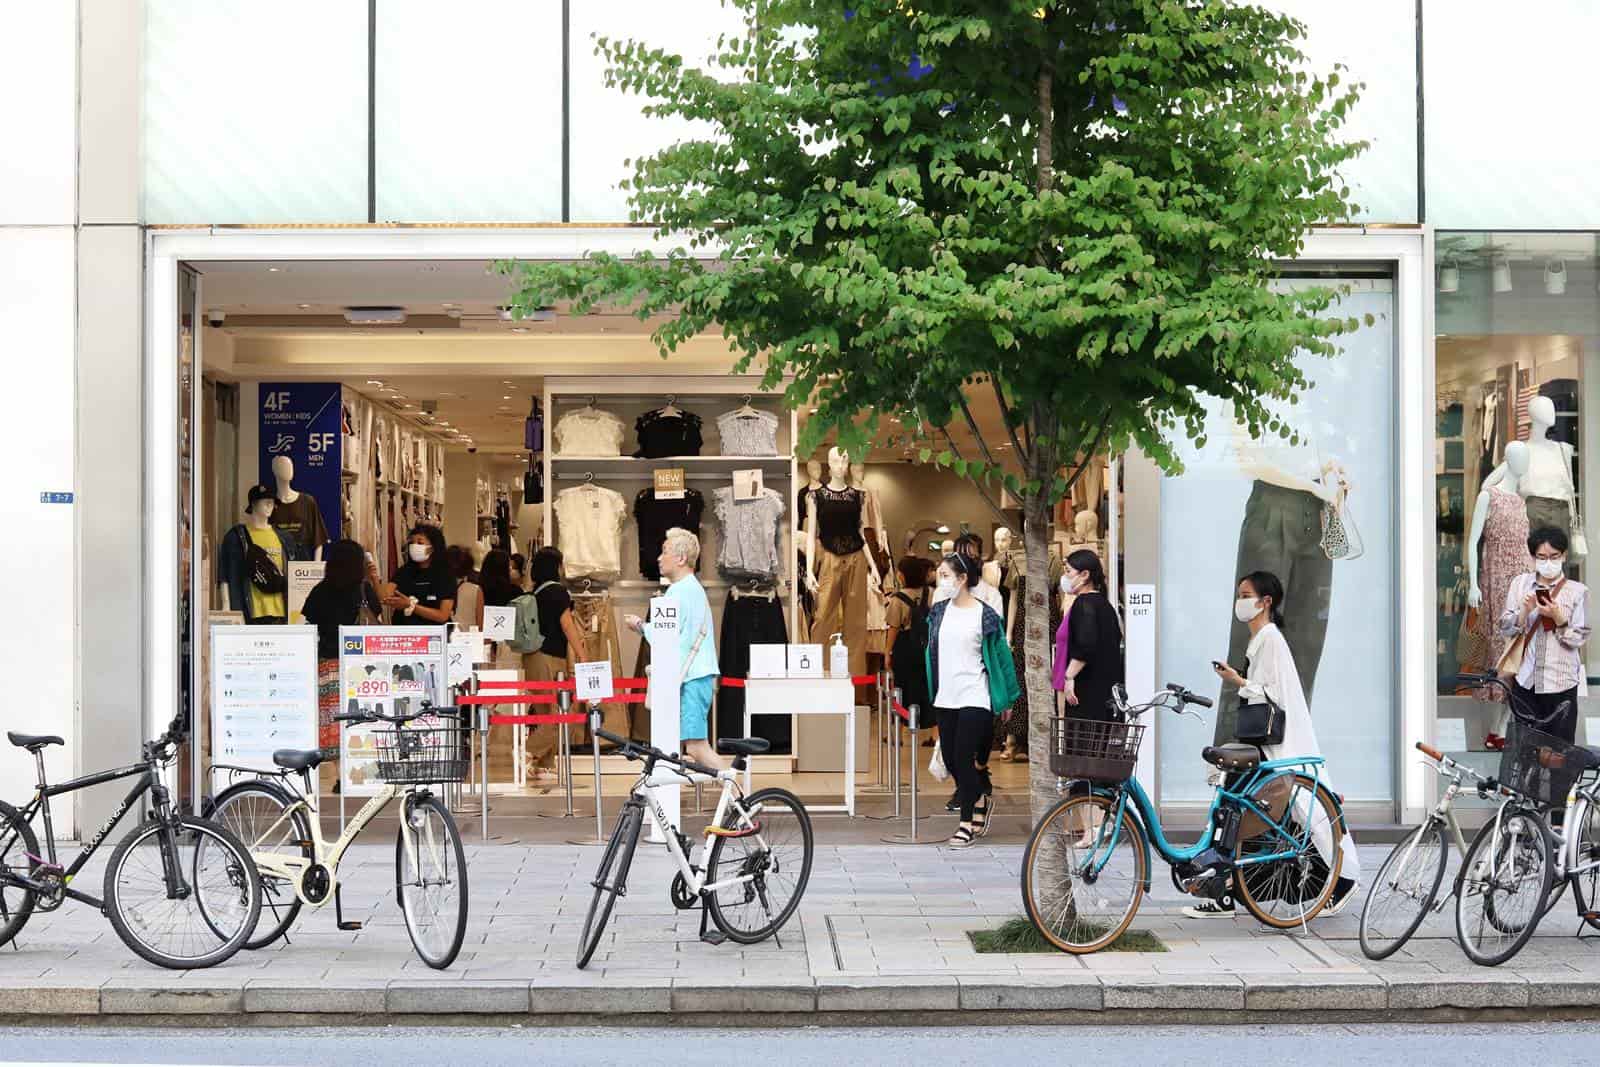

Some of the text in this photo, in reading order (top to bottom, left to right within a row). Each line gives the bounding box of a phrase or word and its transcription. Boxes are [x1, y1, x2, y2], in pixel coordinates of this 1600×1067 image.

[264, 392, 290, 411] 4F
[308, 433, 335, 452] 5F
[308, 454, 324, 462] MEN
[658, 472, 680, 482] NEW
[295, 569, 309, 577] GU
[1129, 593, 1152, 604] 出口
[654, 607, 676, 618] 入口
[1132, 608, 1147, 616] EXIT
[345, 641, 362, 649] GU
